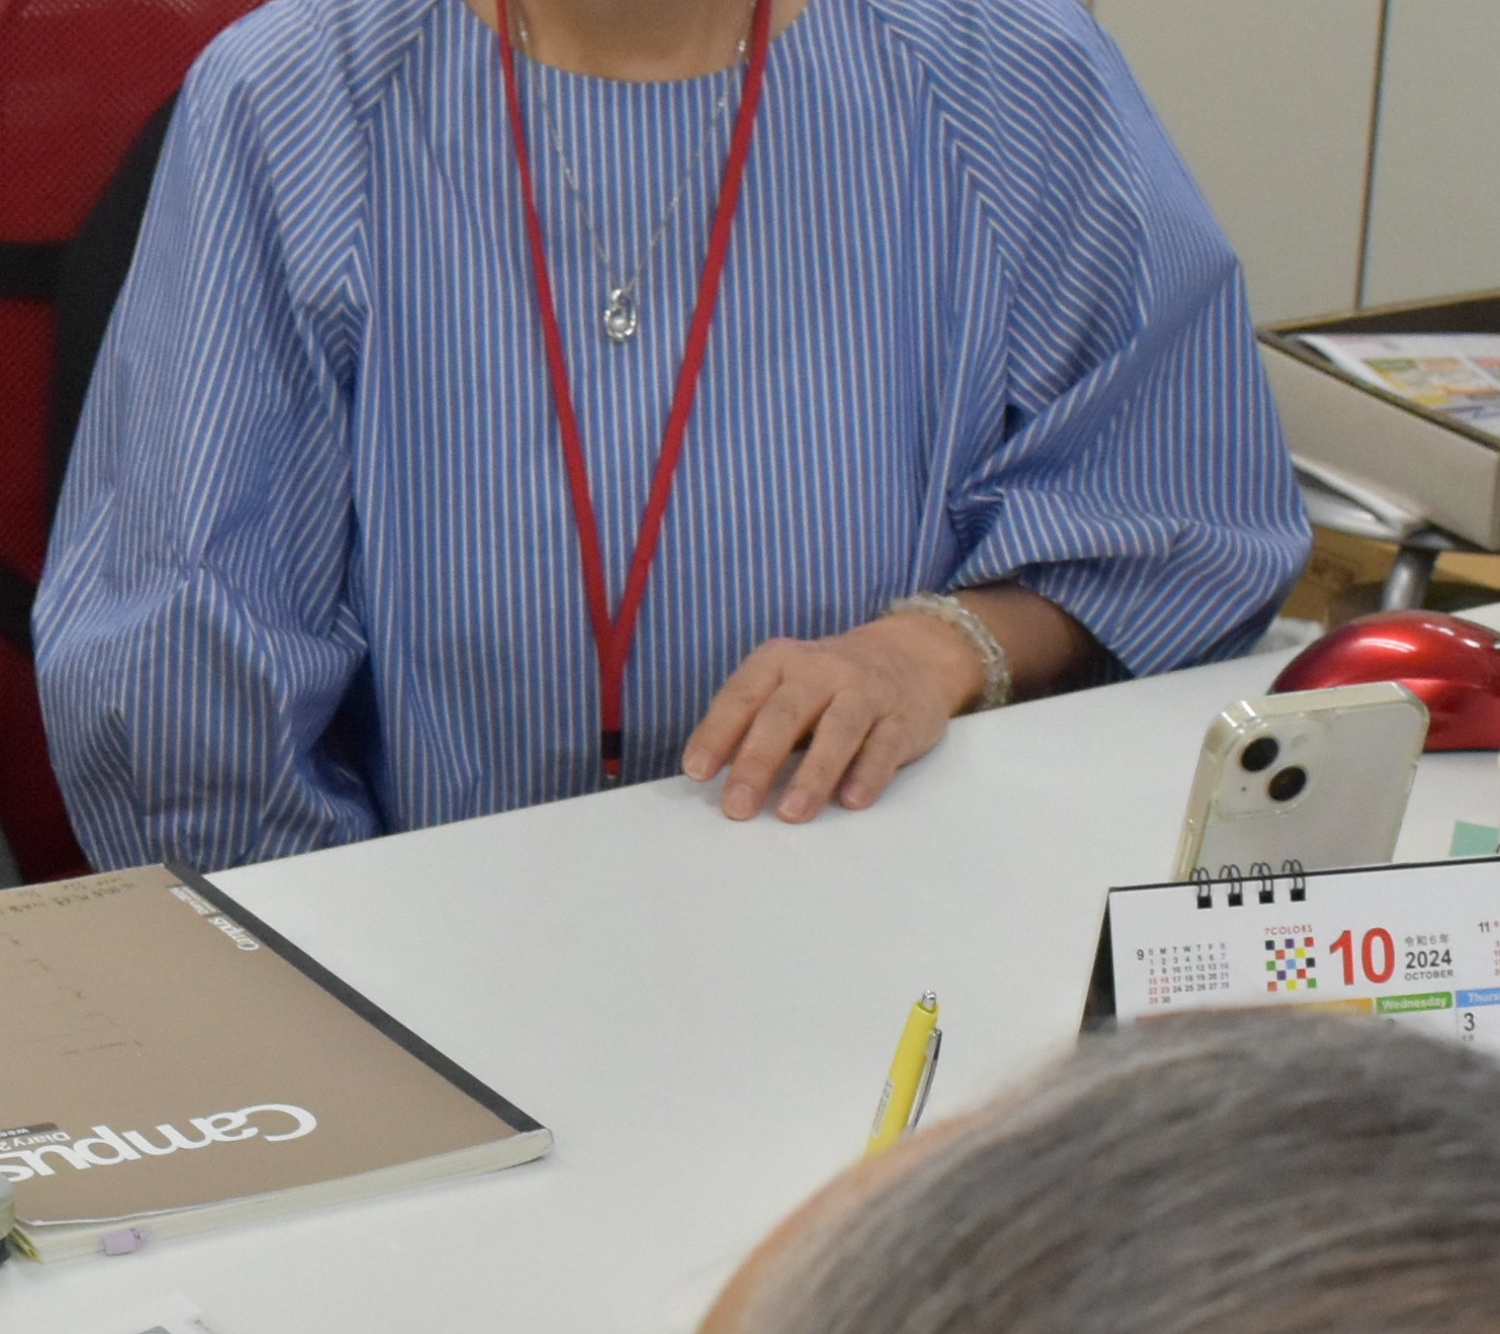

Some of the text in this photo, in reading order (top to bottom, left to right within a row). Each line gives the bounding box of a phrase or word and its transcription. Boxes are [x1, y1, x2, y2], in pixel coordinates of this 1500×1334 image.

[1264, 925, 1313, 936] 7COLORS
[1479, 922, 1490, 933] 11
[1136, 949, 1144, 961] 9
[1329, 927, 1395, 986] 10
[1404, 949, 1452, 970] 2024
[1404, 969, 1454, 981] OCTOBER
[1382, 995, 1447, 1012] Wednesday
[1463, 1013, 1476, 1032] 3
